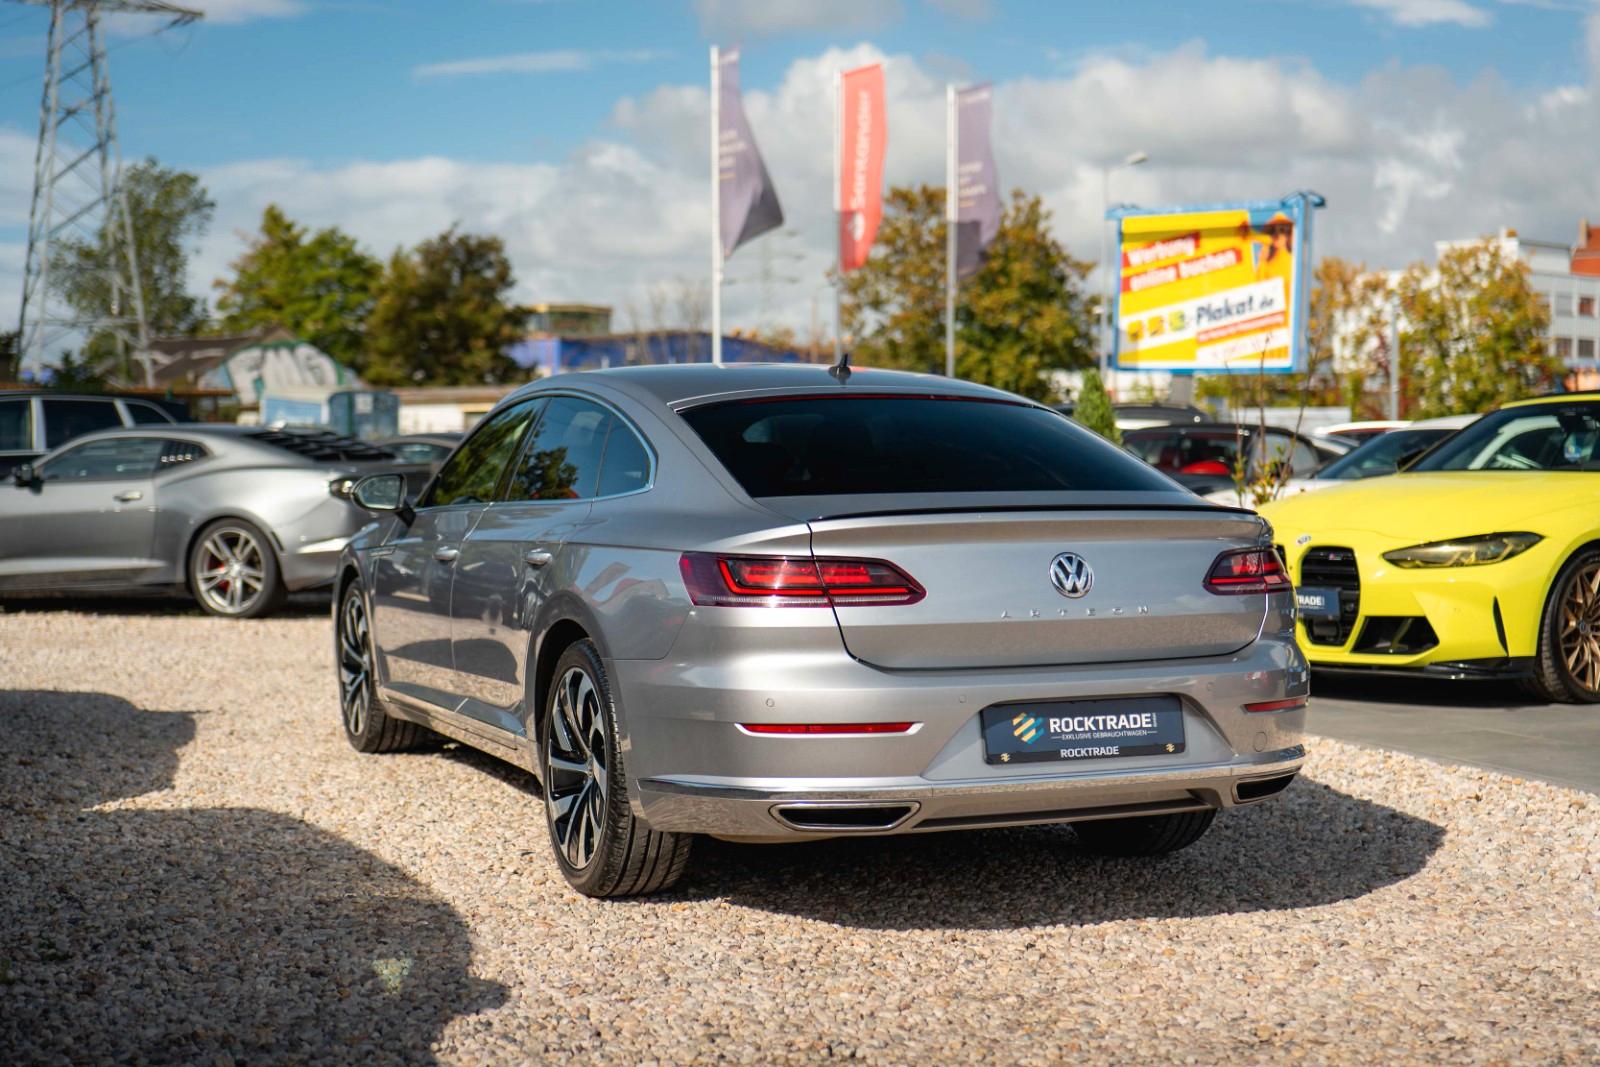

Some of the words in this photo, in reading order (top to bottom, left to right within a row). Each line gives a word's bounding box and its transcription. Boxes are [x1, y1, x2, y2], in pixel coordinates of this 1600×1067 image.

[1178, 249, 1237, 278] buchen
[1001, 605, 1149, 619] ARTEON
[1049, 713, 1152, 733] ROCKTRADE
[1062, 732, 1092, 741] EXKLUSIVE
[1092, 729, 1147, 739] GEBRAUCHTWAGEN
[1060, 746, 1119, 758] ROCKTRADE
